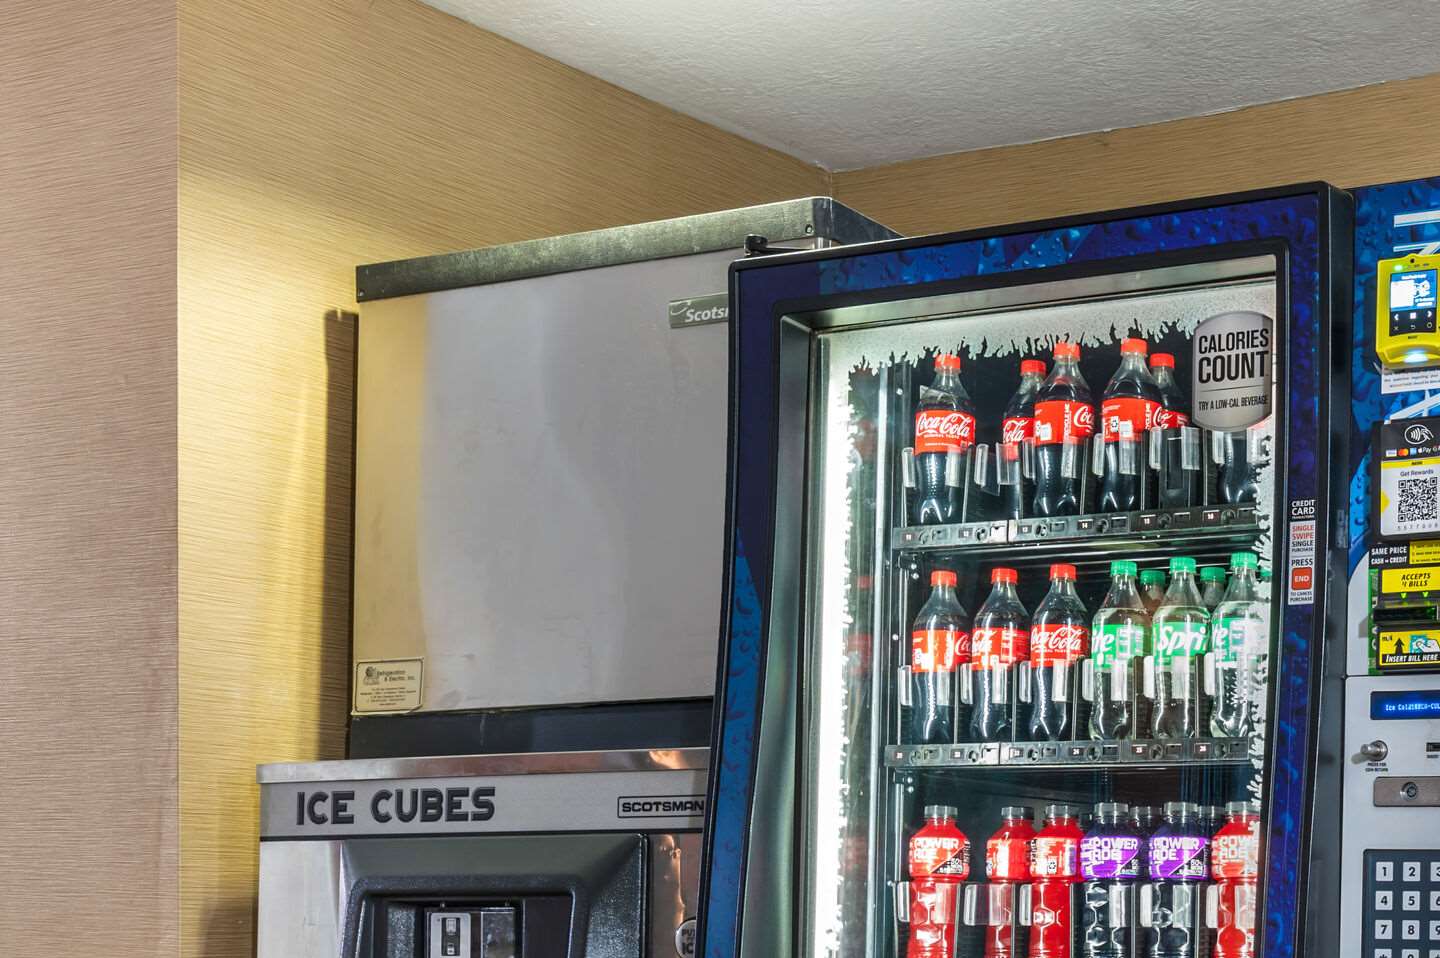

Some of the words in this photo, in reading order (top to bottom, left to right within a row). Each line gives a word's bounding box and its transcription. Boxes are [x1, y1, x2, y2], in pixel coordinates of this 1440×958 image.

[1198, 328, 1269, 355] CALORIES
[1198, 350, 1269, 384] COUNT
[1198, 400, 1209, 411] TRY
[1209, 400, 1214, 410] A
[1215, 397, 1240, 410] LOW-CAL
[1291, 500, 1314, 508] CREDIT
[1291, 506, 1315, 516] CARD
[1292, 532, 1313, 541] SWIPE
[1291, 540, 1313, 548] SINGLE
[1371, 547, 1388, 556] SAME
[1389, 545, 1408, 555] PRICE
[1291, 558, 1313, 567] PRESS
[1371, 557, 1384, 565] CASH
[1389, 556, 1408, 564] CREDIT
[1294, 575, 1310, 583] END
[1400, 572, 1431, 582] ACCEPTS
[1408, 579, 1428, 588] BILLS
[1385, 654, 1407, 663] INSERT
[1407, 654, 1421, 662] BILL
[1422, 653, 1438, 661] HERE
[296, 789, 355, 825] ICE
[370, 787, 496, 824] CUBES
